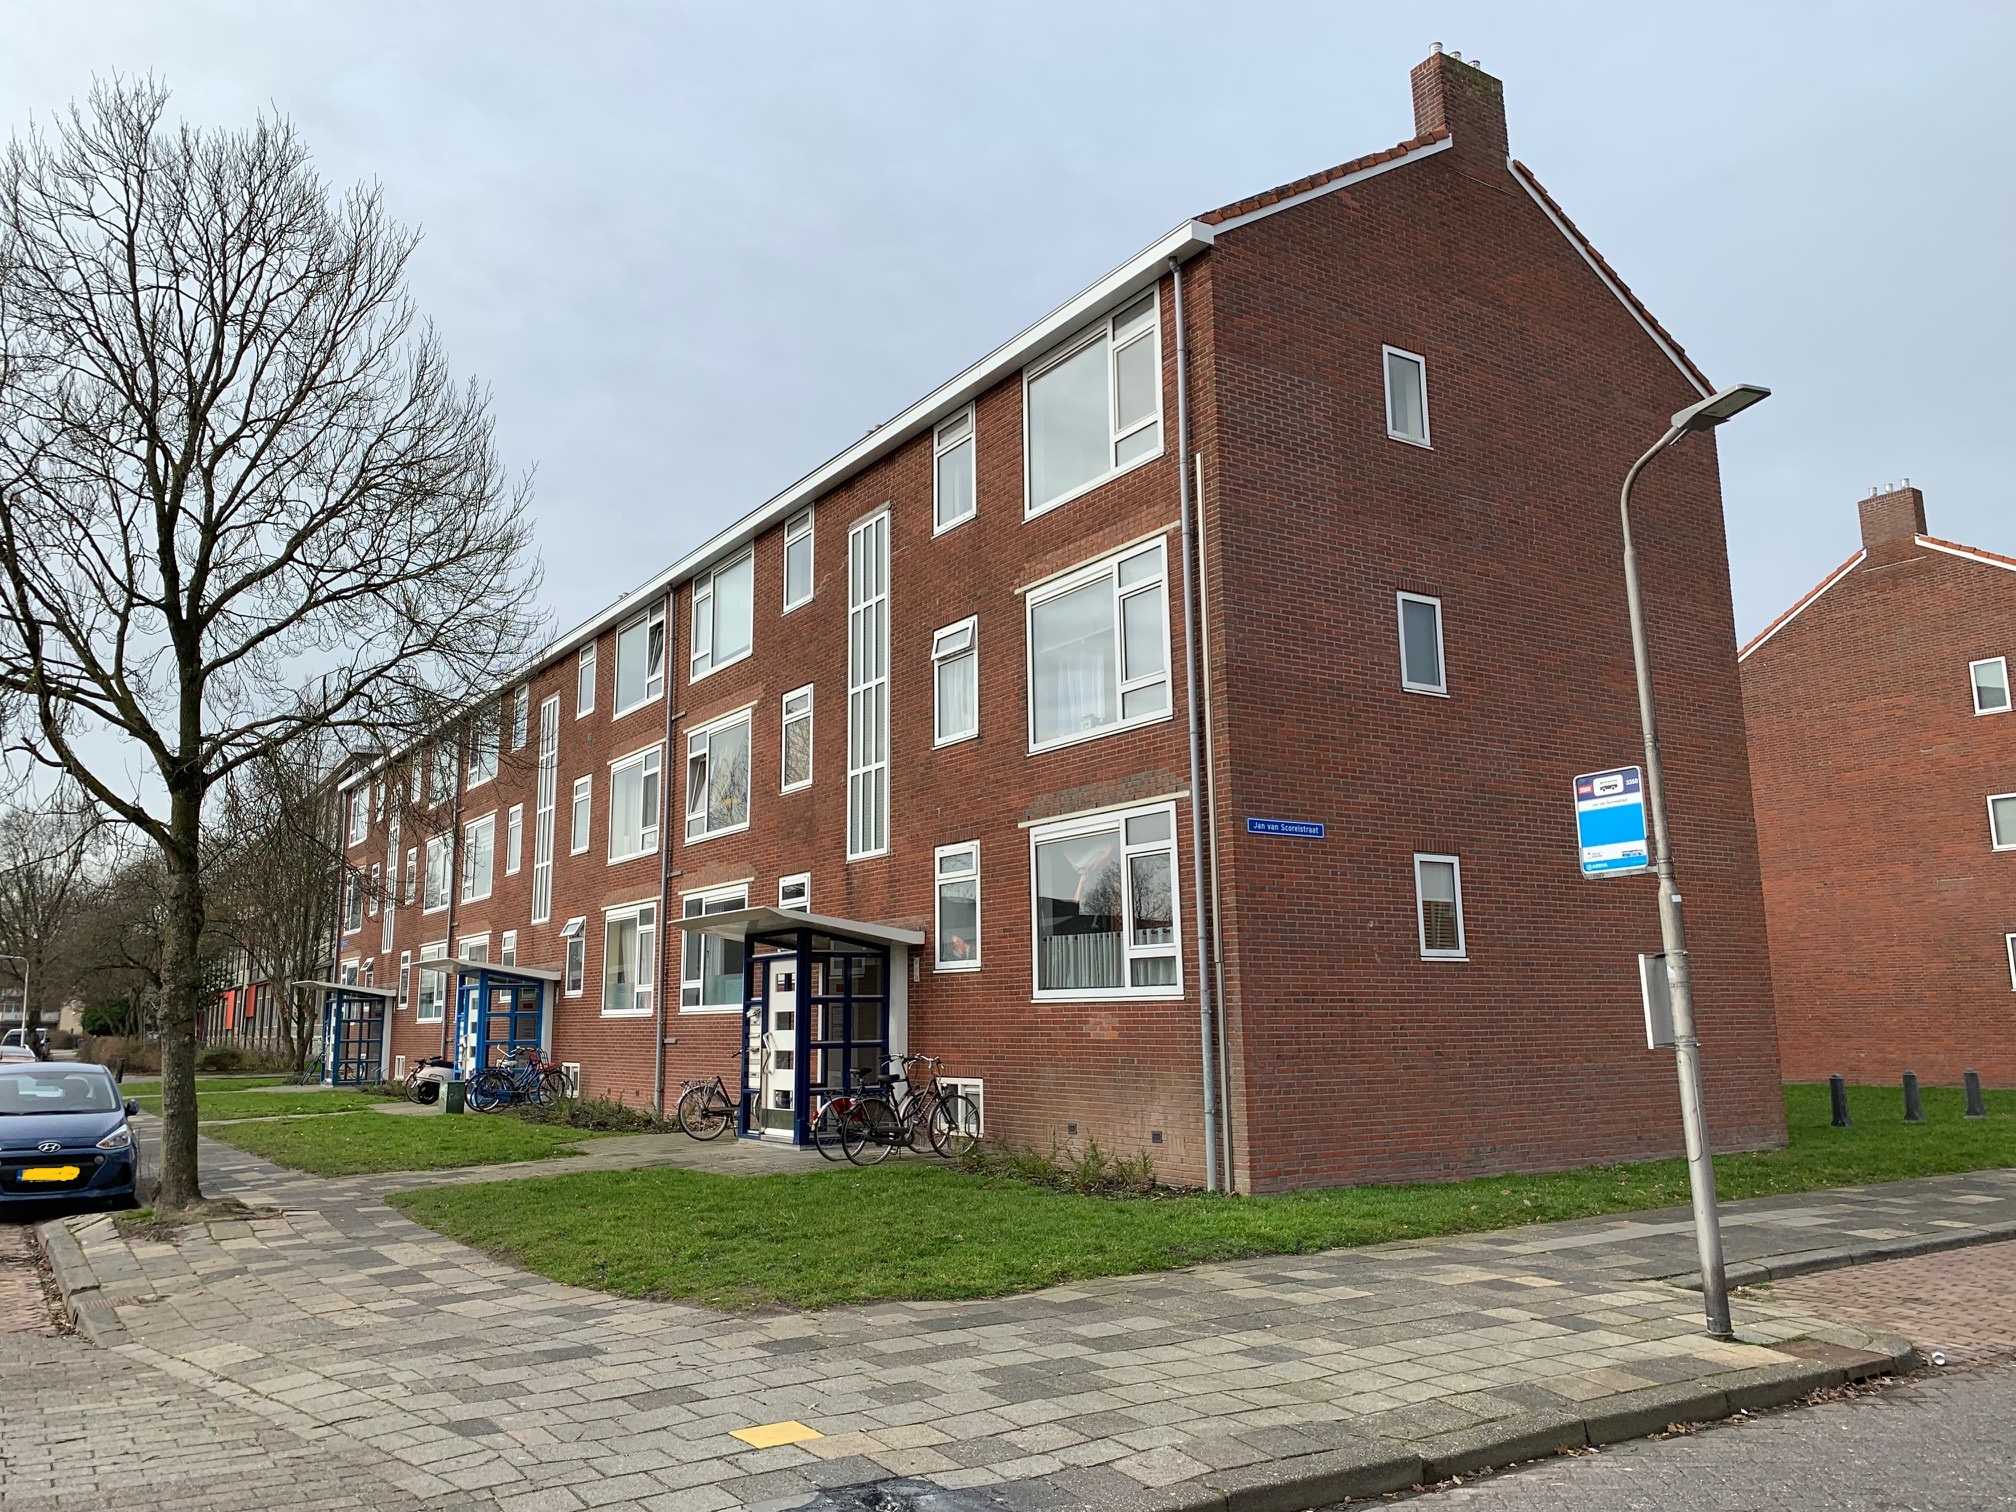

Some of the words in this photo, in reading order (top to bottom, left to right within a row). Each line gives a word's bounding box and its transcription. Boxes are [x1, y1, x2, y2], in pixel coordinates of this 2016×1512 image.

[1253, 821, 1265, 829] Jan
[1267, 823, 1279, 831] van
[1280, 823, 1319, 834] Scorelstraat
